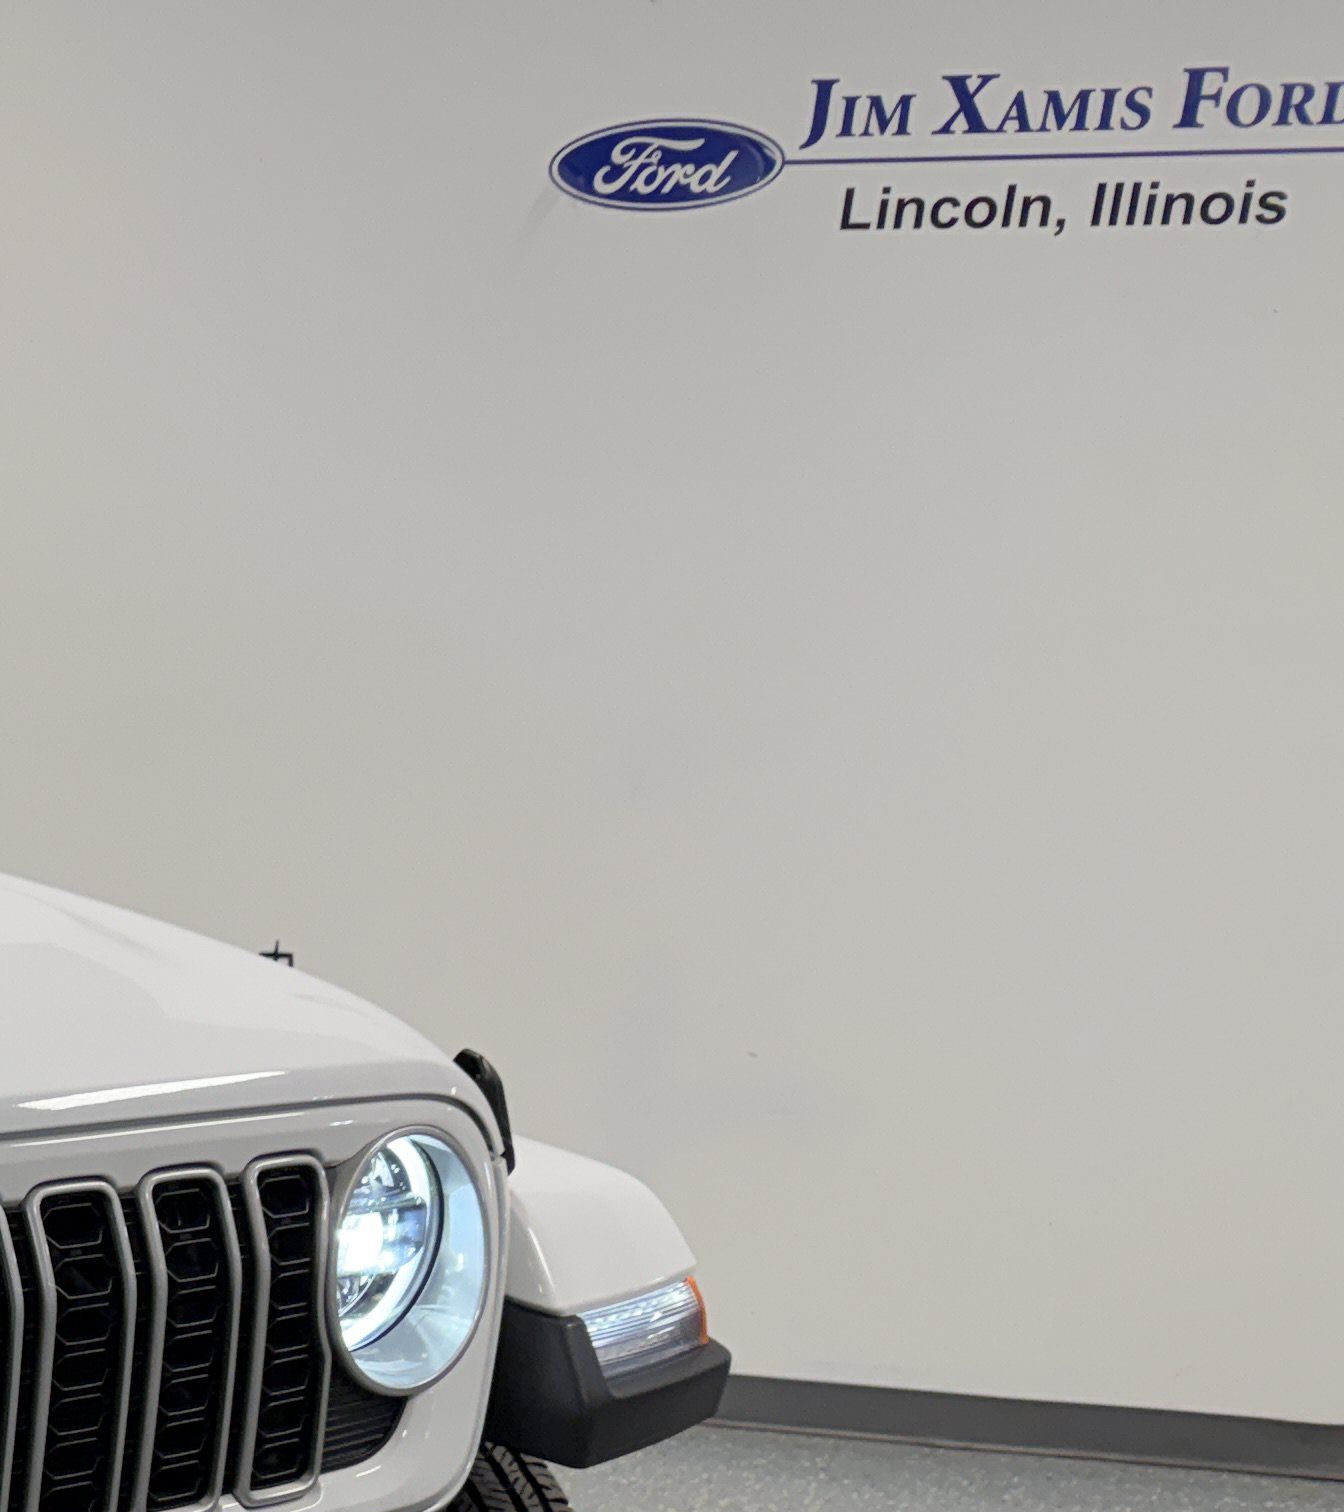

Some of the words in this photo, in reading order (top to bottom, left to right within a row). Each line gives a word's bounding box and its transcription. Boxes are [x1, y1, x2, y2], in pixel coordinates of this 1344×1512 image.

[798, 78, 917, 150] JIM
[932, 73, 1153, 136] XAMIS
[593, 135, 741, 195] Ford
[839, 183, 1066, 237] Lincoln,
[1090, 179, 1288, 227] Illinois
